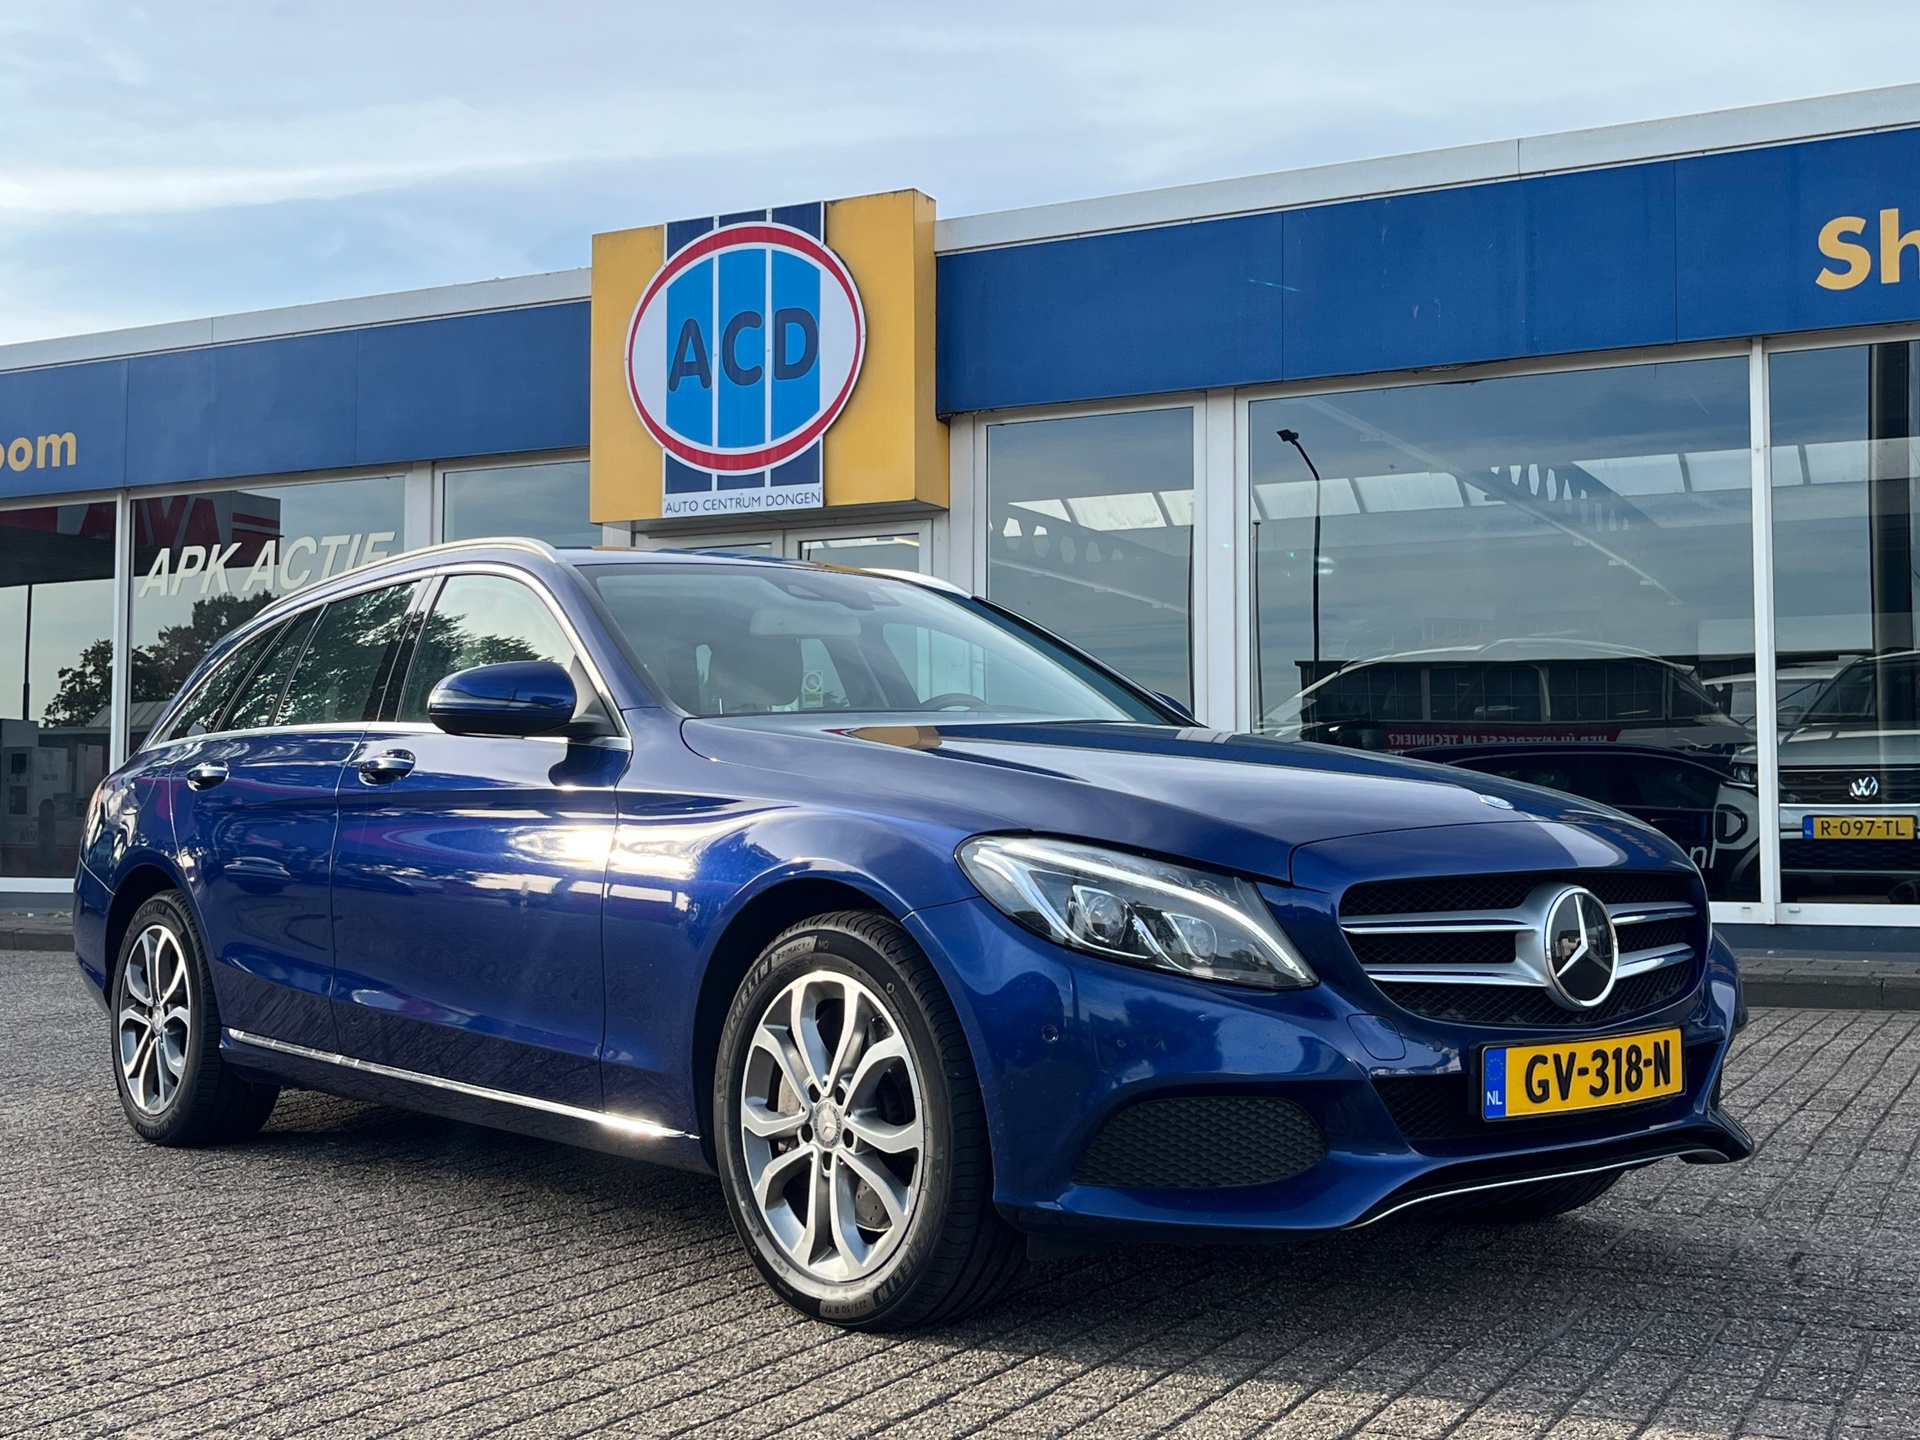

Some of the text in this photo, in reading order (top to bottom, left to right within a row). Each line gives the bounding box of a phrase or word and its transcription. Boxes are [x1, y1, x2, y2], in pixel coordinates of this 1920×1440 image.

[668, 307, 819, 392] ACD
[0, 432, 76, 471] om
[665, 492, 821, 513] AUTO CENTRUM DONGEN
[138, 542, 242, 598] APK
[1820, 820, 1906, 836] R-097-TL
[1486, 1040, 1671, 1106] NL GV-318-N
